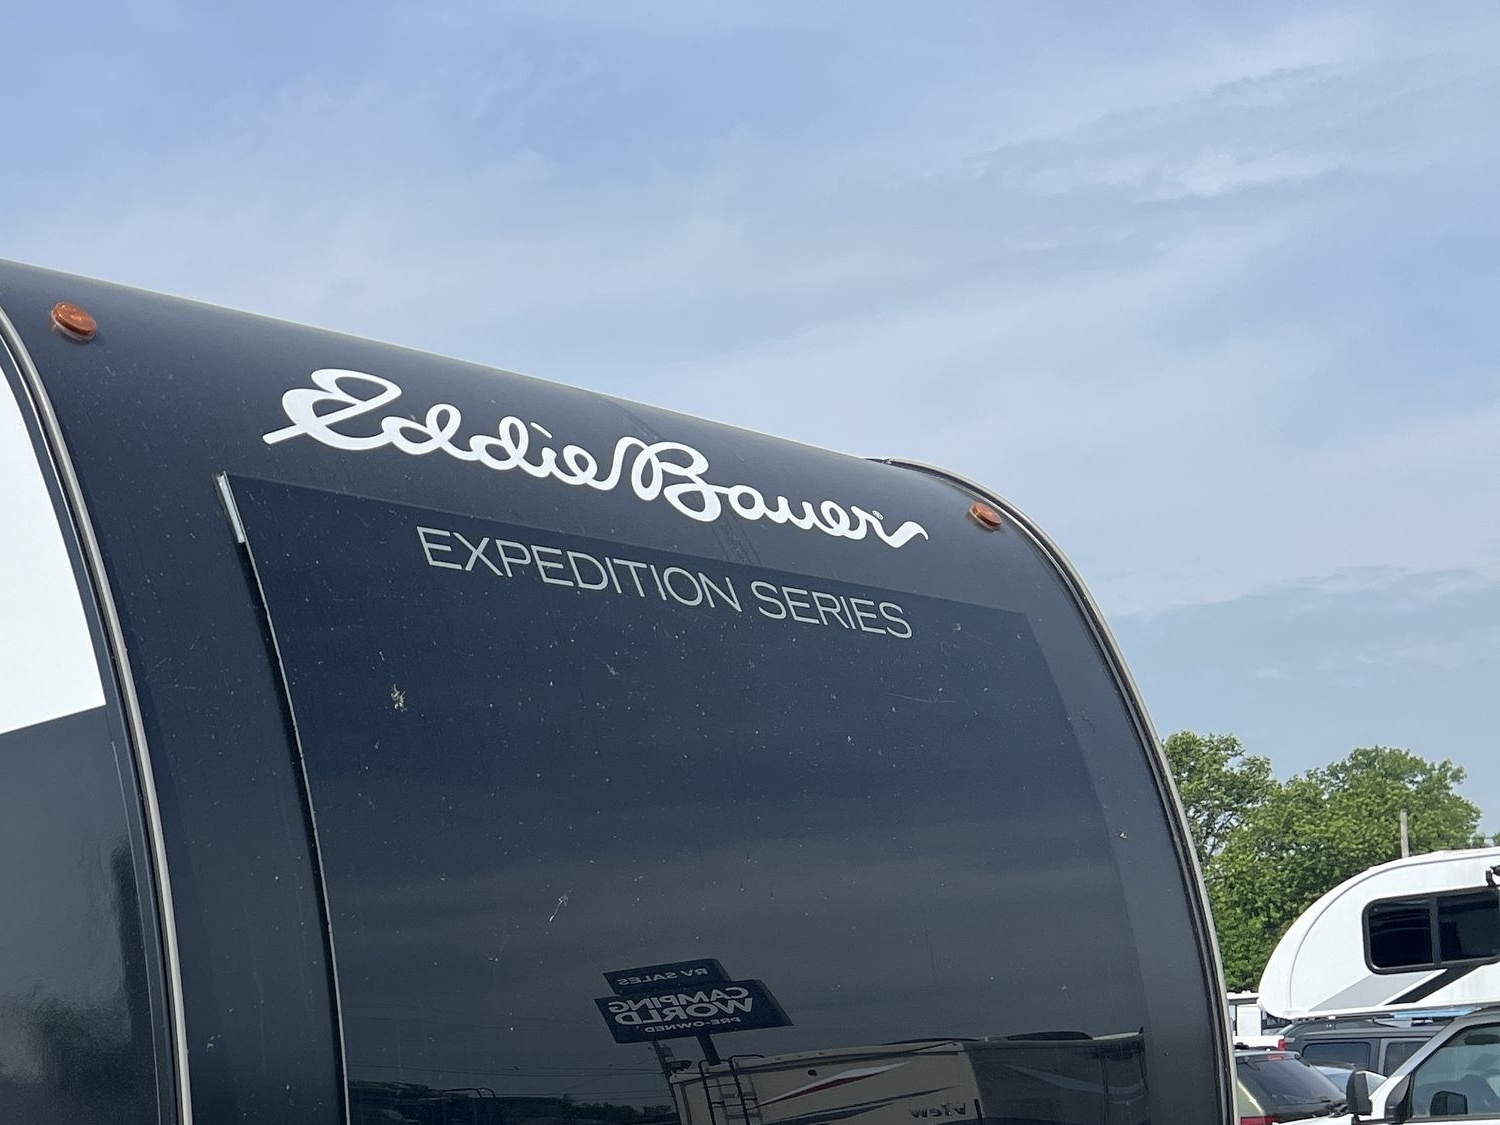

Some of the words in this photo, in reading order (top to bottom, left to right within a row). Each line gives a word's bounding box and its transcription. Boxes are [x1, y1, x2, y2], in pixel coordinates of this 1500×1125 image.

[263, 368, 608, 490] Eddie
[614, 436, 929, 548] Bauer
[416, 525, 742, 613] EXPEDITION
[750, 580, 913, 639] SERIES
